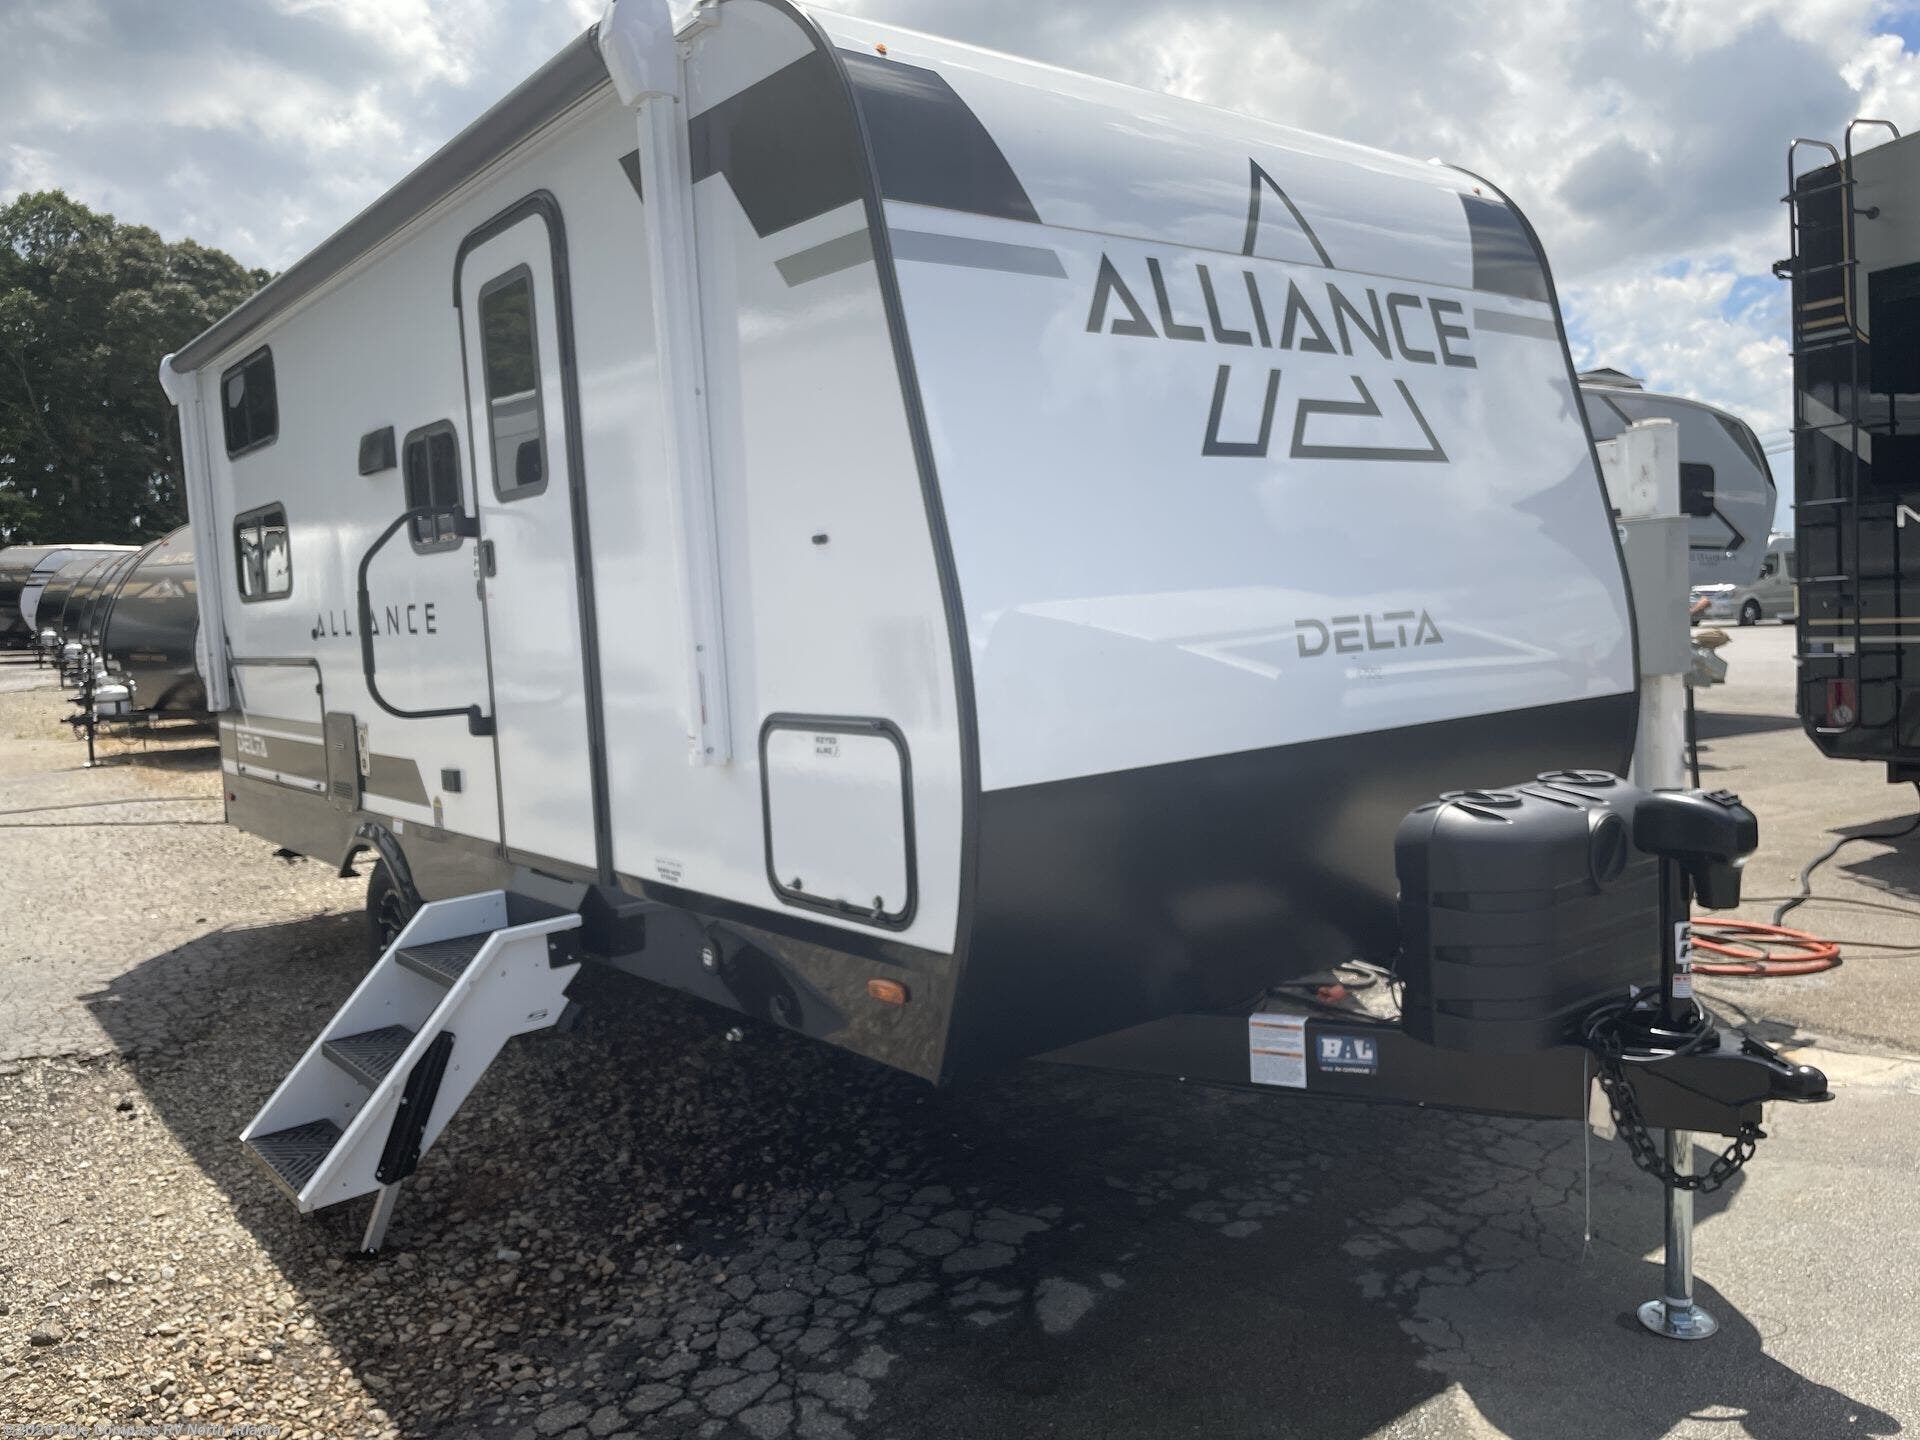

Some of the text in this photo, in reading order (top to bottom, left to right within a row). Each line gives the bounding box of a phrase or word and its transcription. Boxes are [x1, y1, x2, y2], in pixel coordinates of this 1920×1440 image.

[1086, 251, 1478, 369] ALLIANCE
[316, 602, 437, 637] ALLANCE
[1295, 609, 1443, 659] DELTA
